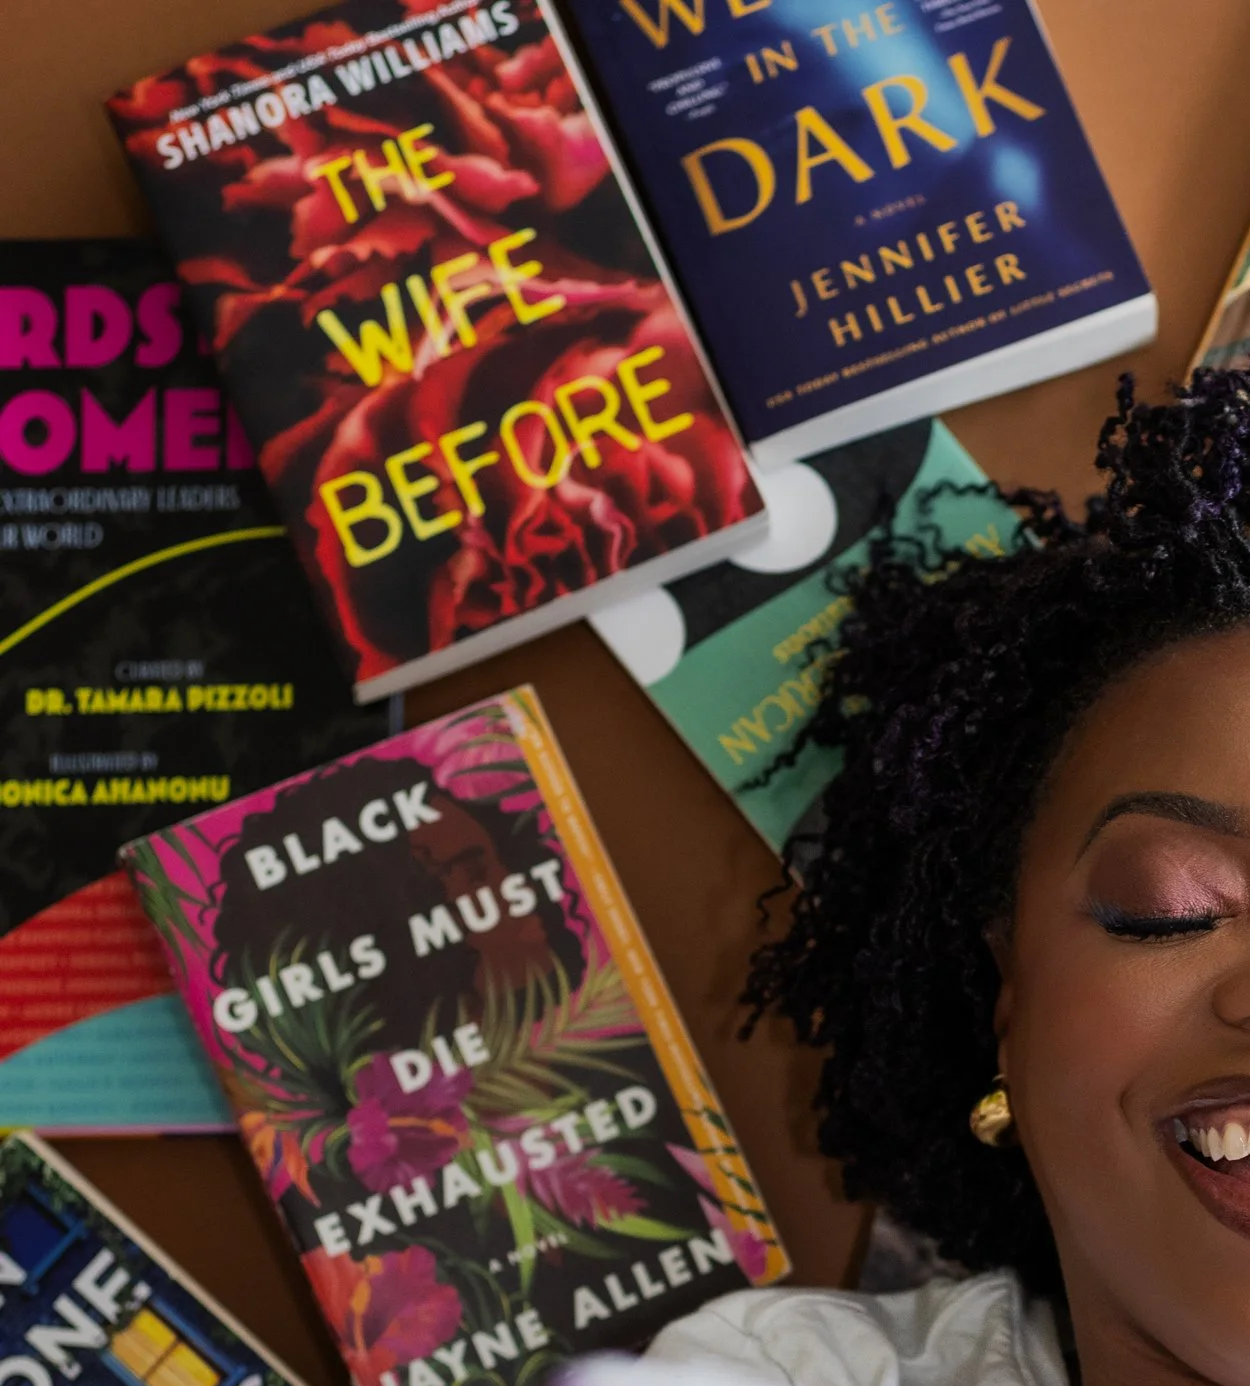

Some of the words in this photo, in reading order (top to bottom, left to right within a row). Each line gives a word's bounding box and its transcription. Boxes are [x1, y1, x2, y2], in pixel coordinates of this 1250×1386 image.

[156, 74, 338, 170] SHANORA
[334, 0, 520, 96] WILLIAMS
[744, 40, 799, 84] IN
[811, 1, 908, 56] THE
[310, 123, 454, 223] THE
[680, 37, 1046, 236] DARK
[317, 227, 566, 387] WIFE
[790, 200, 1026, 318] JENNIFER
[828, 252, 1027, 347] HILLIER
[319, 346, 694, 567] BEFORE
[24, 687, 73, 716] DR.
[75, 685, 183, 715] TAMARA
[186, 682, 294, 711] PIZZOLI
[245, 781, 442, 892] BLACK
[212, 935, 386, 1035] GIRLS
[407, 858, 568, 957] MUST
[389, 1022, 491, 1094] DIE
[313, 1084, 658, 1258] EXHAUSTED
[488, 1259, 502, 1272] A
[509, 1231, 569, 1264] NOVEL
[572, 1227, 739, 1331] ALLEN
